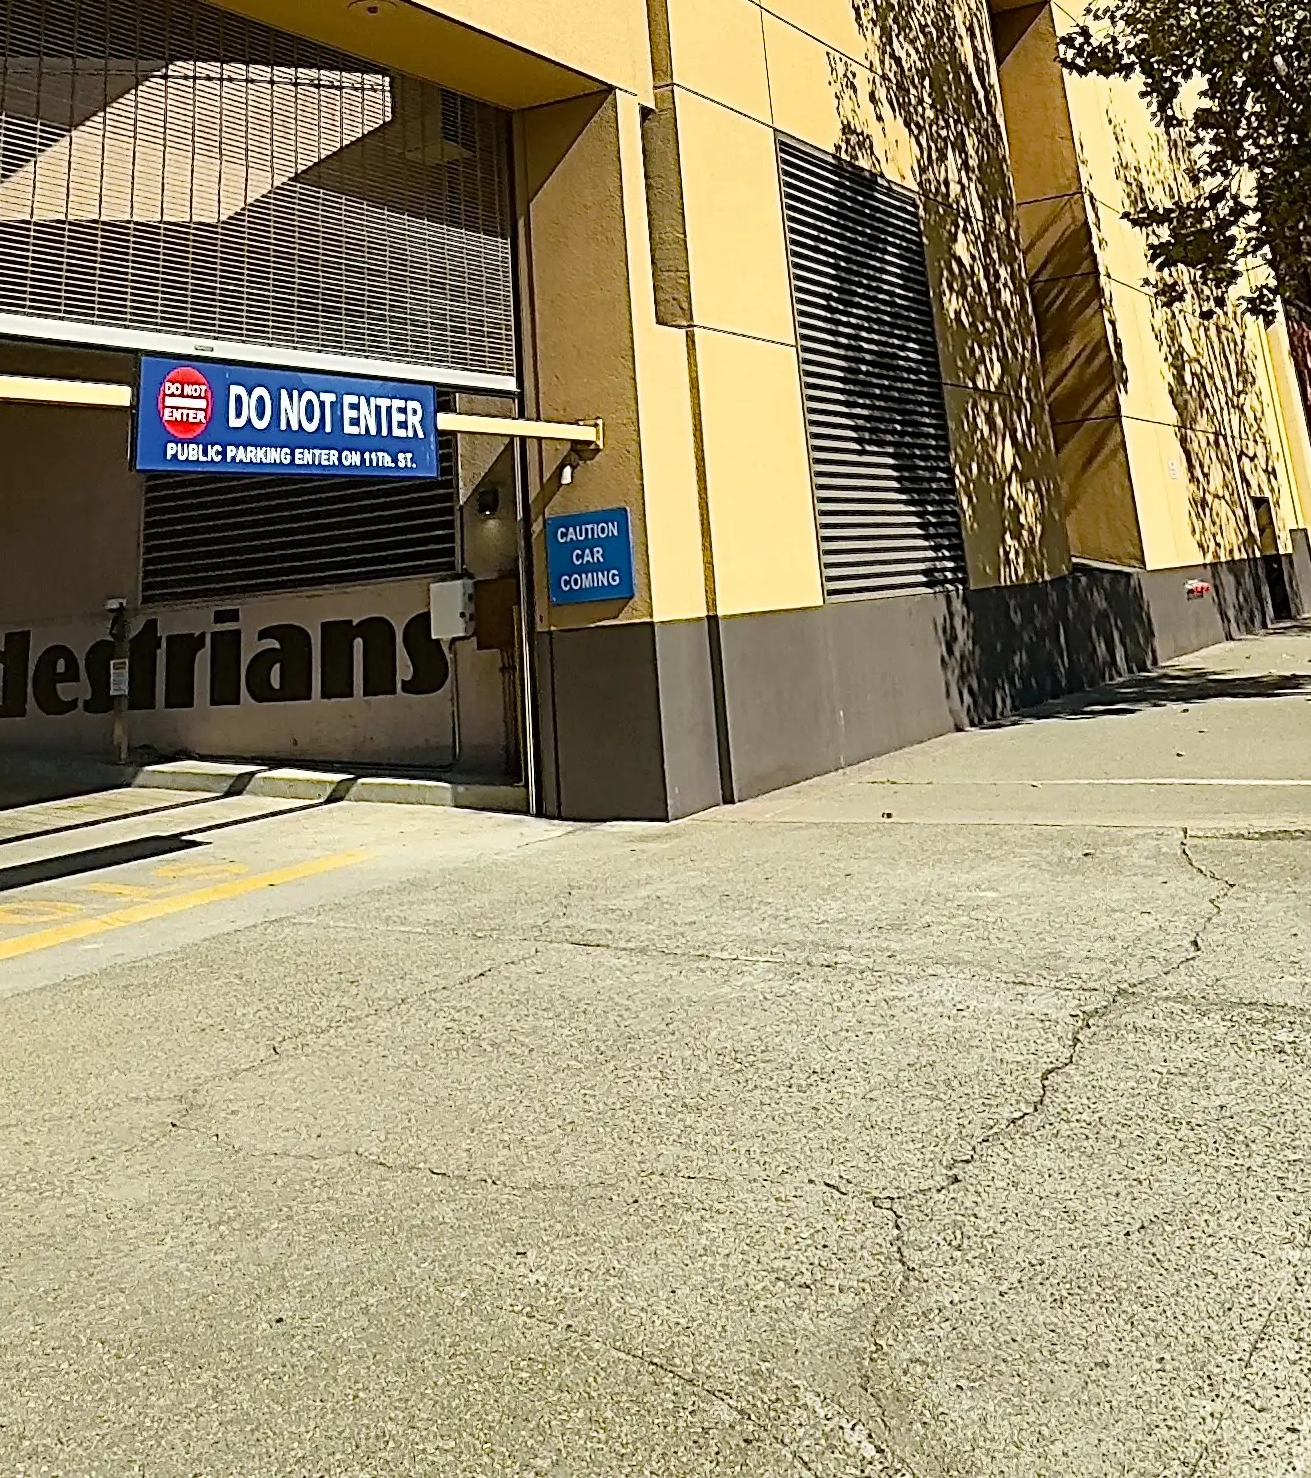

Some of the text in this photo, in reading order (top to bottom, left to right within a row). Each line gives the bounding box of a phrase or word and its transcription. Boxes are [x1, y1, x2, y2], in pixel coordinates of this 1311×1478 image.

[164, 382, 207, 397] DO NOT
[163, 407, 206, 423] ENTER
[228, 384, 425, 439] DO NOT ENTER
[166, 442, 222, 462] PUBLIC
[226, 445, 291, 465] PARKING
[294, 448, 339, 466] ENTER
[342, 450, 361, 467] ON
[397, 452, 417, 468] ST.
[557, 521, 619, 543] CAUTION
[572, 546, 604, 565] CAR
[560, 569, 620, 592] COMING
